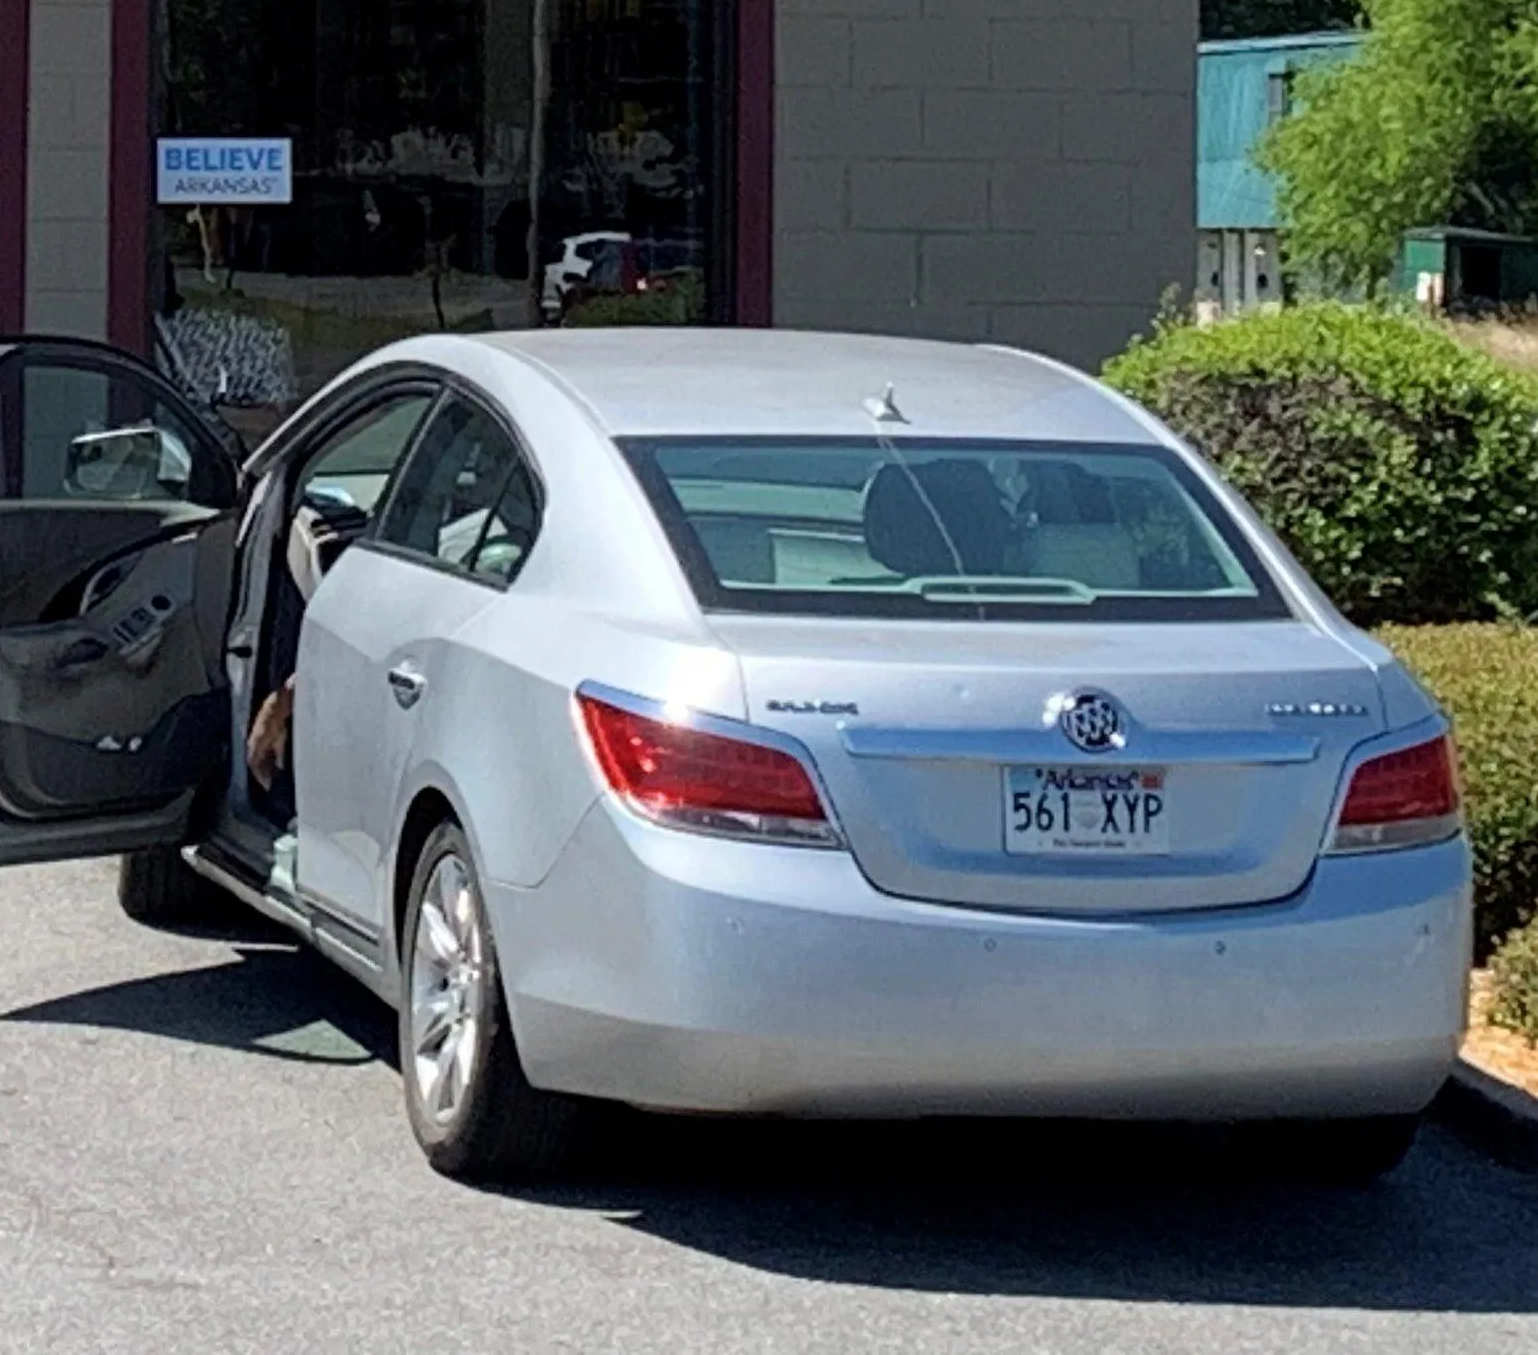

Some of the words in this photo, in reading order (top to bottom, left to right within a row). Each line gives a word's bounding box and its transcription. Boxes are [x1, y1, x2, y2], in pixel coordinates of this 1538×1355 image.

[164, 147, 283, 171] BELIEVE
[1013, 791, 1071, 833] 561
[1100, 793, 1163, 834] XYP
